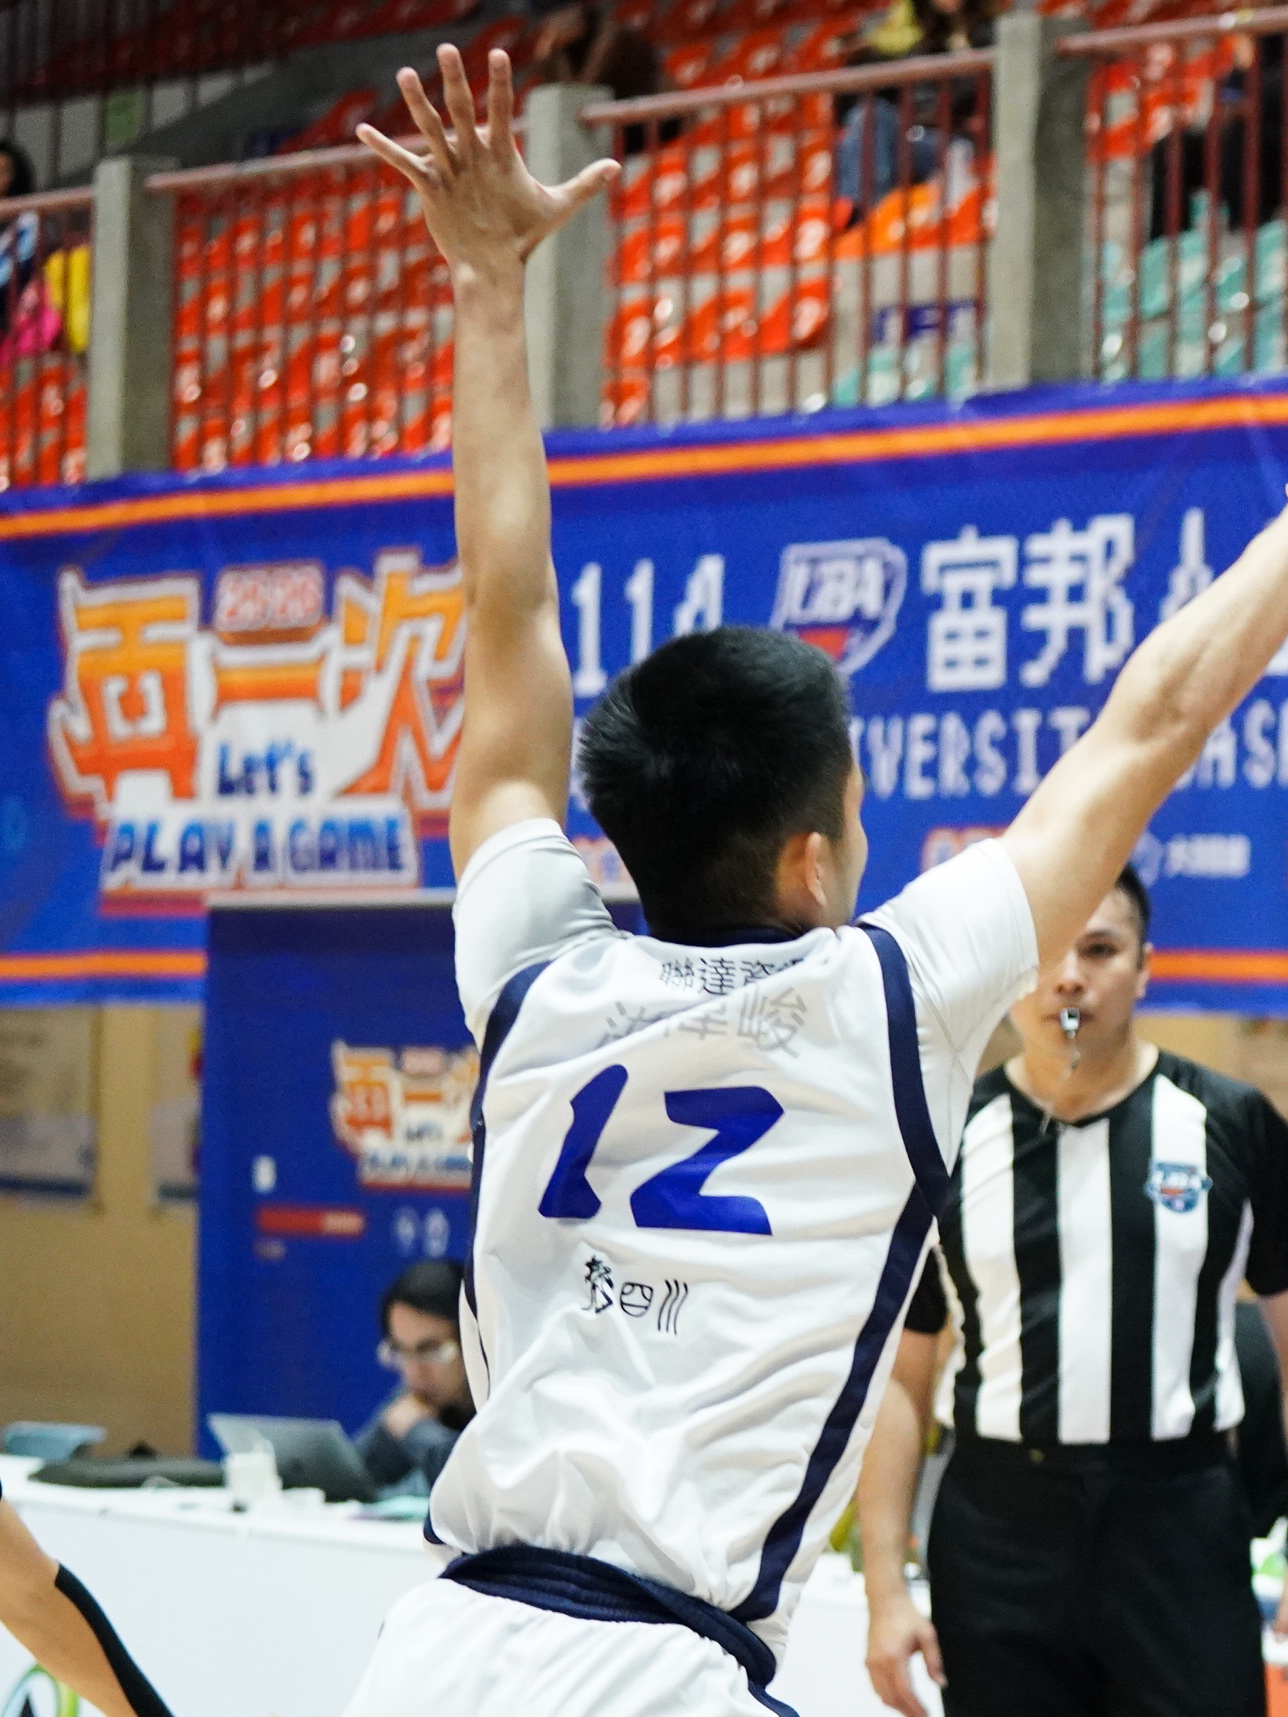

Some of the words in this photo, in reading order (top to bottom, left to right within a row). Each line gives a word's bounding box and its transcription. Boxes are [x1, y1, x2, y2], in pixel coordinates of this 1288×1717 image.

[216, 741, 314, 794] Let's
[110, 816, 235, 874] PLAY
[288, 816, 404, 873] GAME
[537, 1064, 785, 1236] 12
